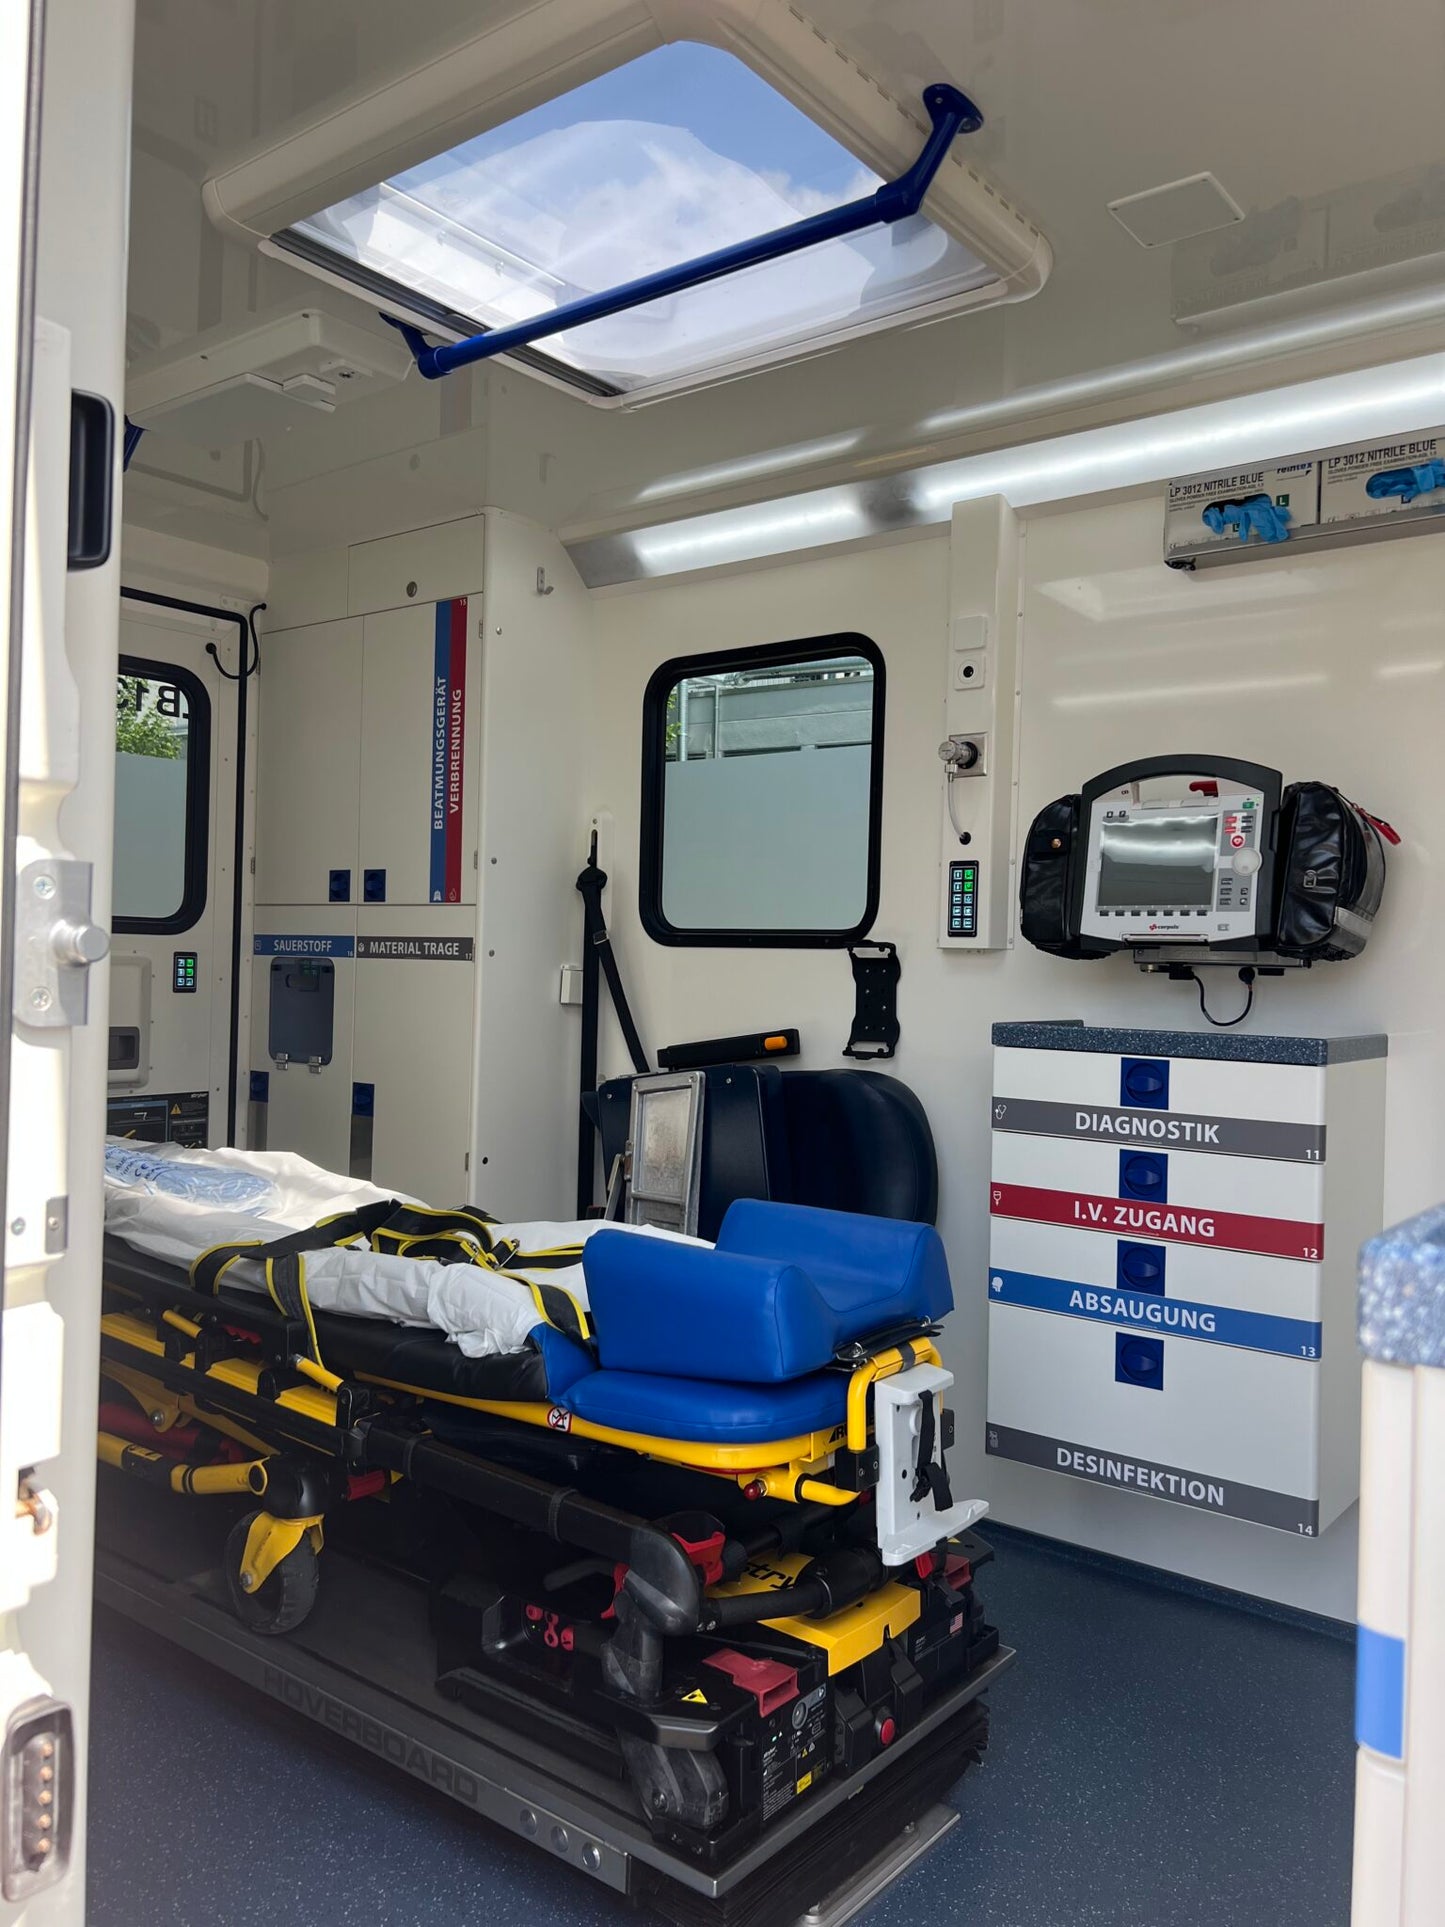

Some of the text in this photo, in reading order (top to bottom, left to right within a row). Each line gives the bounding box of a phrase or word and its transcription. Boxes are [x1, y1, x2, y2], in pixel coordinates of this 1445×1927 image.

[1329, 439, 1437, 469] LP 3012 NITRILE BLUE
[1169, 472, 1264, 498] LP 3012 NITRILE BLUE
[459, 599, 467, 607] 15
[434, 676, 447, 830] BEATMUNGSGERÄT
[449, 689, 462, 814] VERBRENNUNG
[273, 939, 333, 952] SAUERSTOFF
[369, 941, 460, 956] MATERIAL TRAGE
[465, 953, 472, 961] 17
[1075, 1111, 1220, 1144] DIAGNOSTIK
[1305, 1149, 1320, 1160] 11
[1074, 1201, 1215, 1237] I.V. ZUGANG
[1302, 1247, 1318, 1259] 12
[1069, 1289, 1216, 1332] ABSAUGUNG
[1300, 1345, 1316, 1357] 13
[1057, 1447, 1224, 1506] DESINFEKTION
[1297, 1523, 1313, 1535] 14
[263, 1665, 478, 1803] HOVERBOARD
